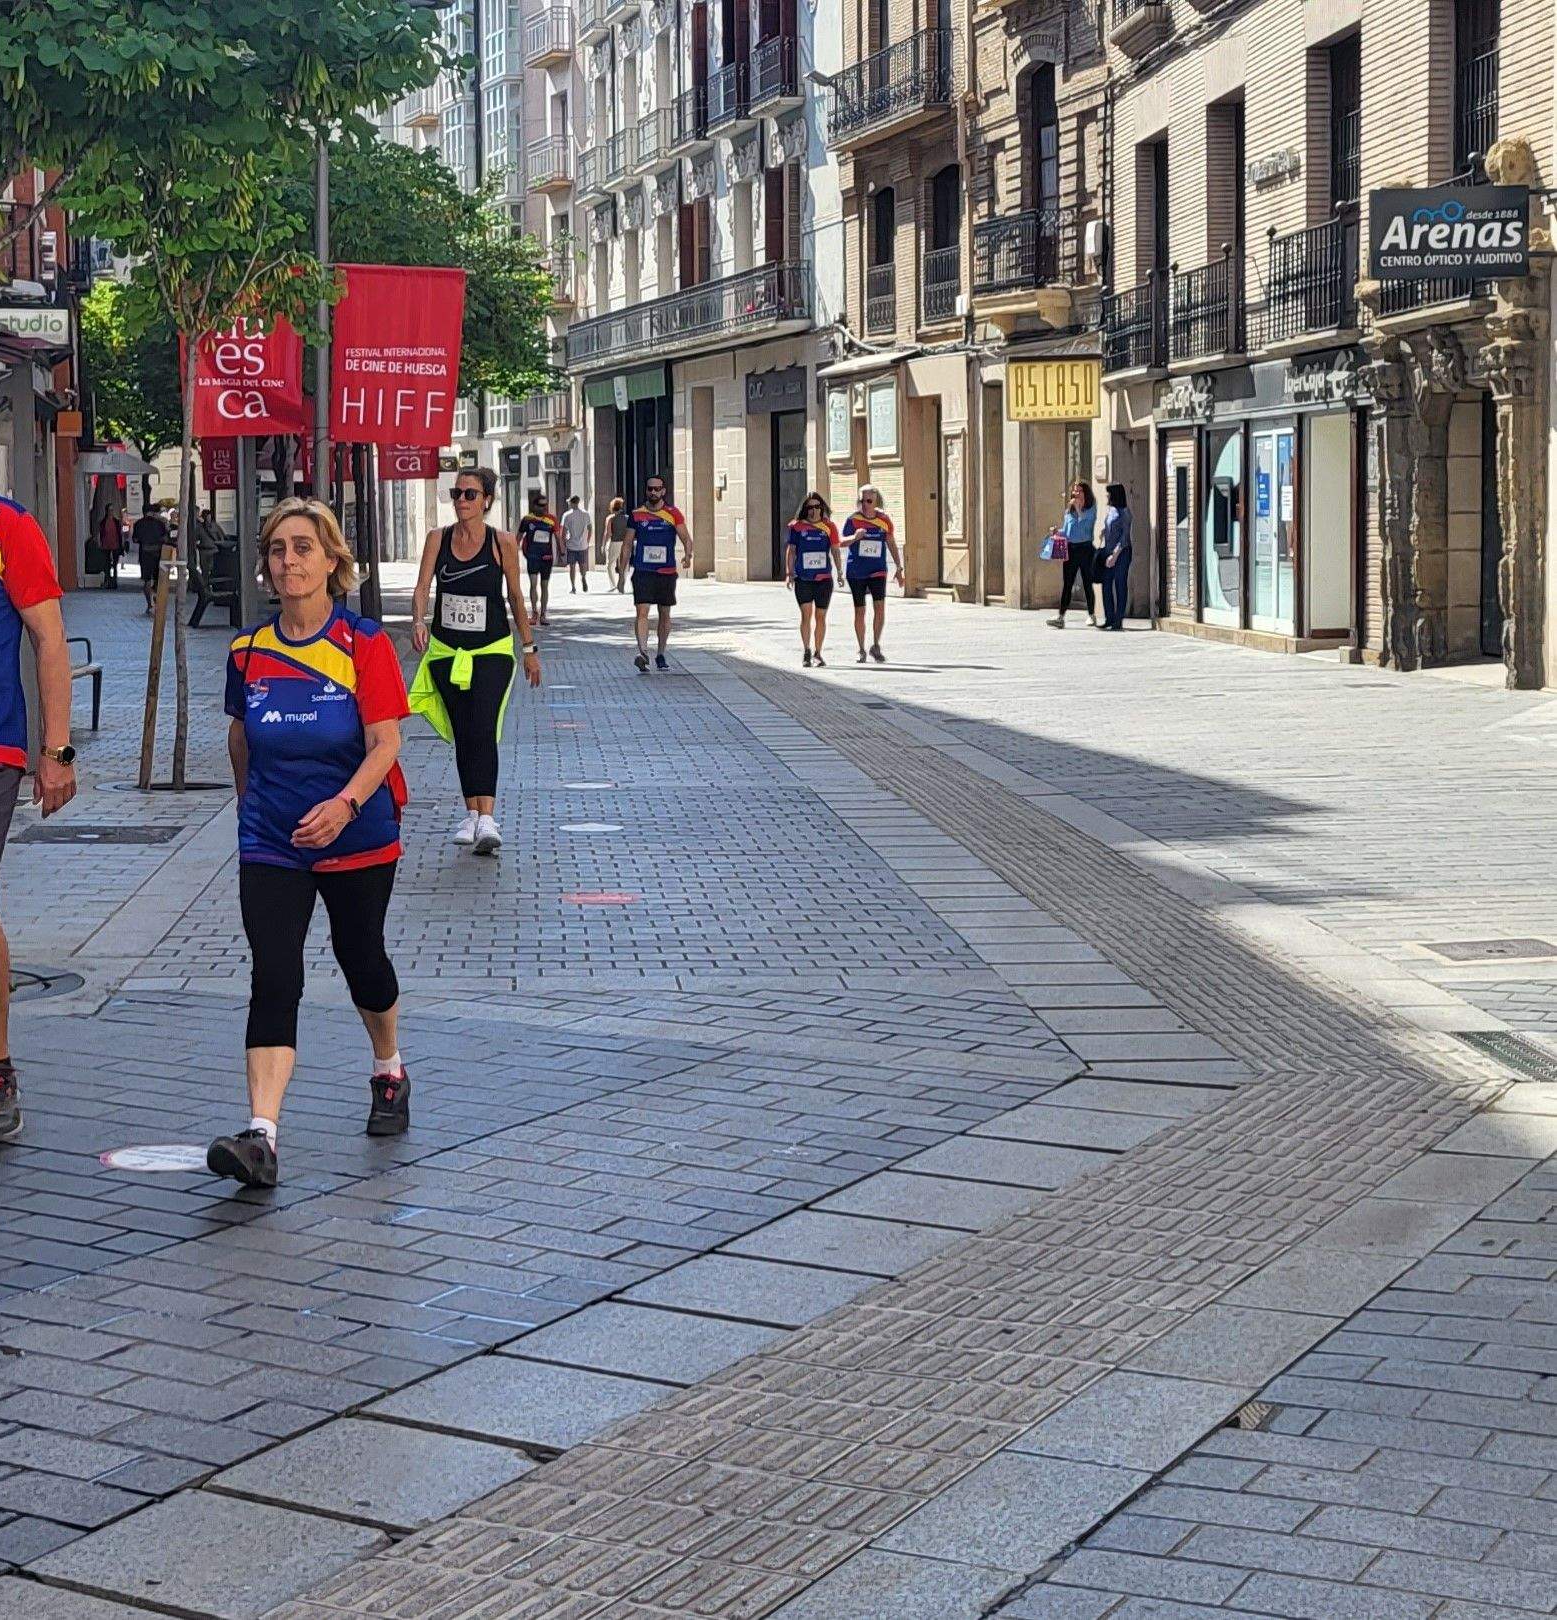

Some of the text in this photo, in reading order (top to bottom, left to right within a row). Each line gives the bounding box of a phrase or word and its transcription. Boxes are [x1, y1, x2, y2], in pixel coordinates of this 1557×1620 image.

[1466, 210, 1493, 220] desde
[1380, 216, 1524, 250] Arenas
[1380, 252, 1523, 267] CENTRO ÓPTICO Y AUDITIVO
[216, 343, 265, 376] es
[345, 348, 448, 358] FESTIVAL INTERNACIONAL
[345, 359, 447, 376] DE CINE DE HUESCA
[1015, 364, 1093, 407] ASCASO
[217, 390, 271, 419] ca
[342, 387, 446, 428] HIFF
[396, 456, 422, 472] ca
[450, 612, 476, 624] 103
[285, 711, 318, 723] mupol
